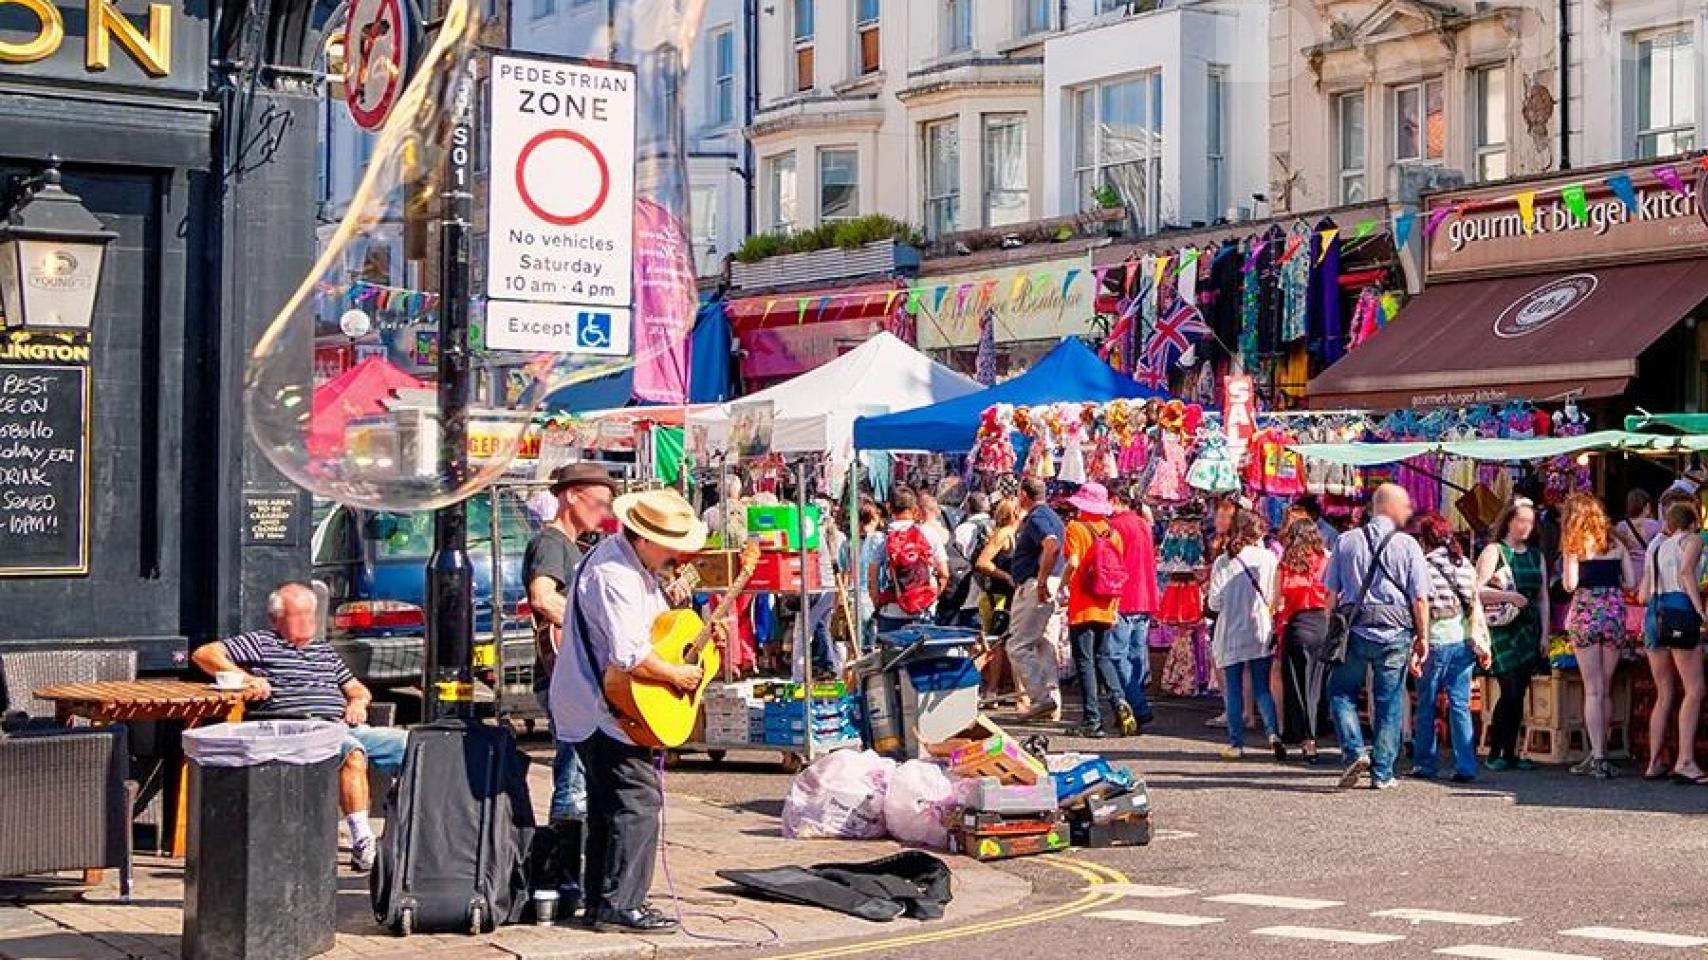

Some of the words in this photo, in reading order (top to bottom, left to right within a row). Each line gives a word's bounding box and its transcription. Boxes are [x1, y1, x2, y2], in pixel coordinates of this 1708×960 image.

[500, 63, 627, 92] PEDESTRIAN
[519, 90, 608, 121] ZONE
[509, 229, 535, 246] No
[541, 230, 614, 252] vehicles
[519, 254, 602, 276] Saturday
[505, 276, 526, 291] 10
[531, 280, 556, 293] am
[570, 280, 584, 295] 4
[588, 282, 615, 298] pm
[508, 317, 571, 336] Except
